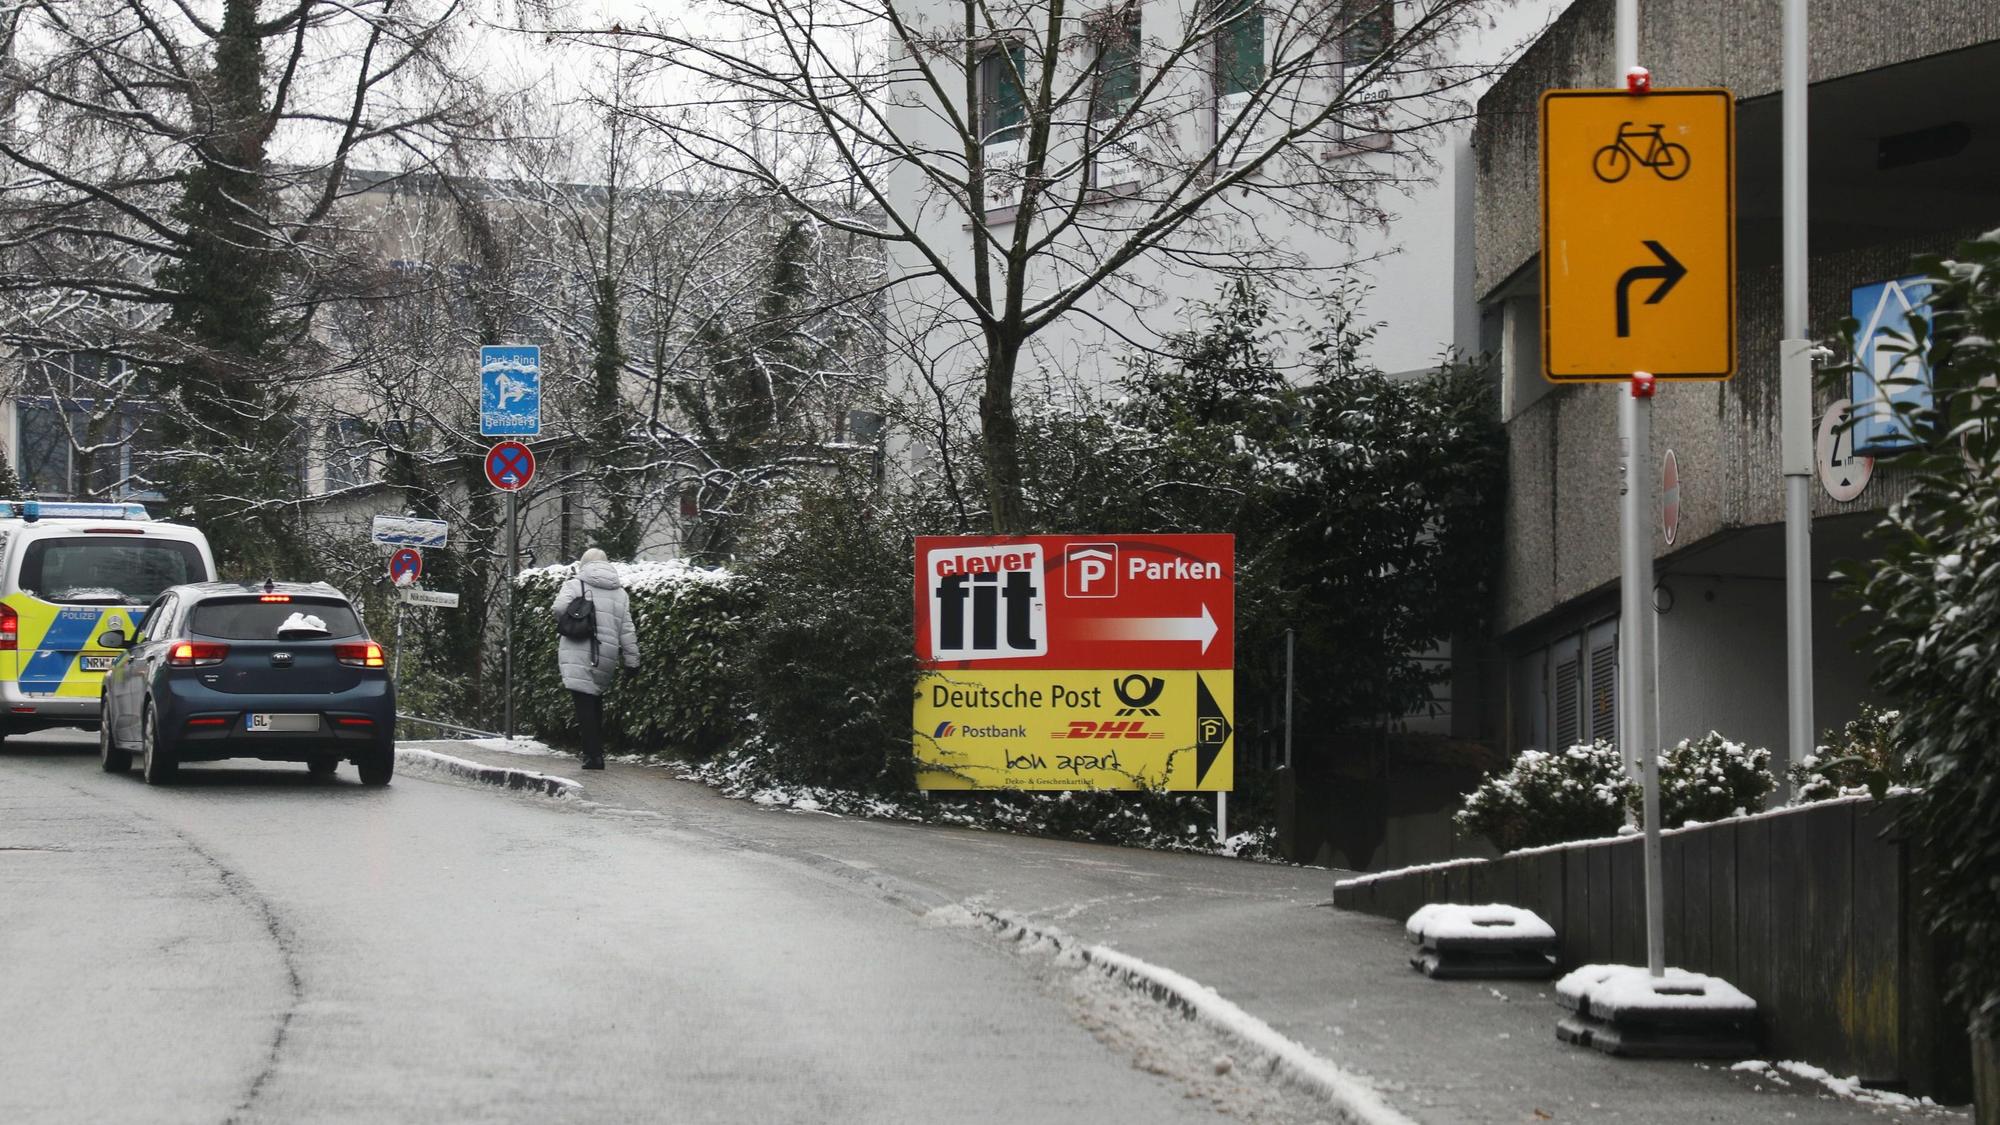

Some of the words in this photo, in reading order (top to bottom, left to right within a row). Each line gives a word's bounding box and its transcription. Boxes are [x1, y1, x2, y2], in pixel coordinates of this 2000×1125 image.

[485, 355, 535, 365] Park-Ring
[485, 415, 535, 429] Bensberg
[936, 552, 1036, 577] clever
[1080, 560, 1106, 592] P
[1128, 557, 1221, 580] Parken
[62, 612, 96, 620] POLIZEI
[936, 572, 1037, 650] fit
[933, 684, 1042, 708] Deutsche
[1052, 685, 1101, 708] Post
[962, 725, 1027, 738] Postbank
[1066, 721, 1150, 739] DHL
[1037, 777, 1094, 785] Geschenkartikel
